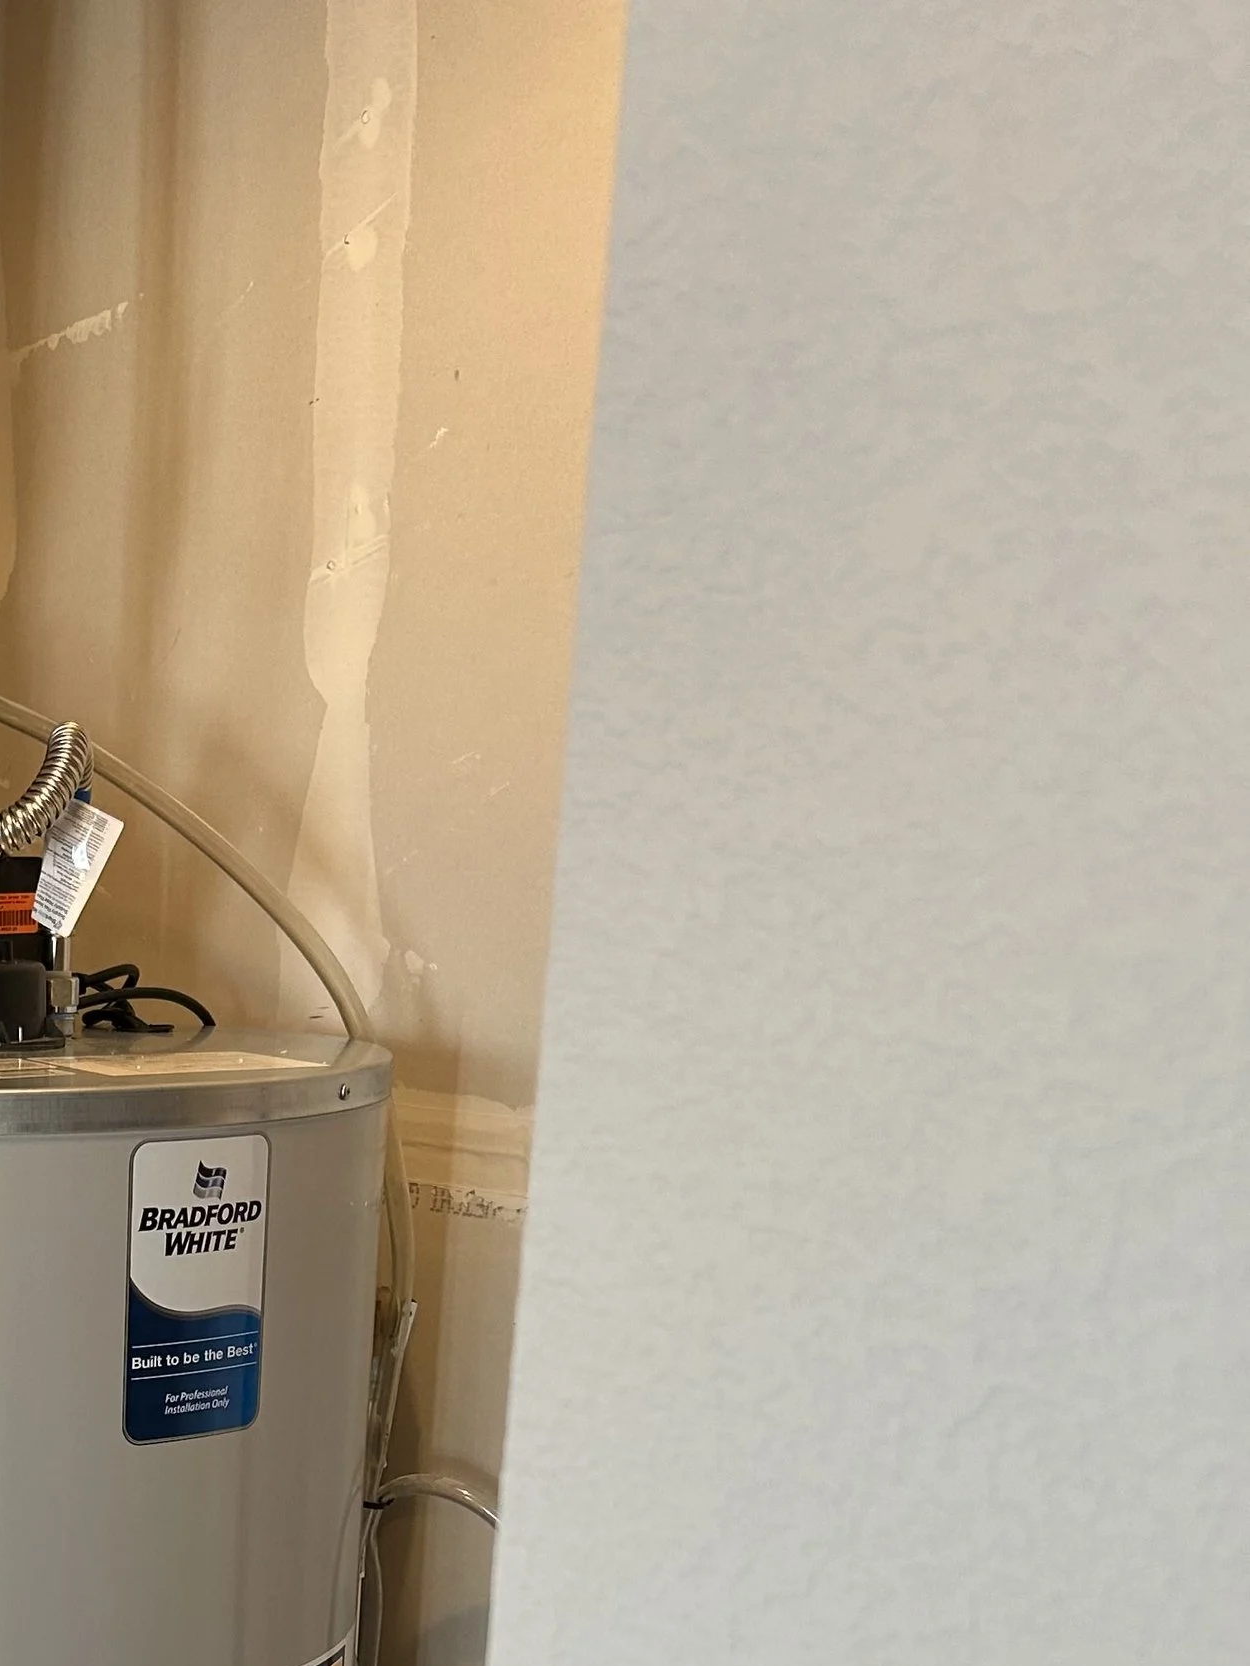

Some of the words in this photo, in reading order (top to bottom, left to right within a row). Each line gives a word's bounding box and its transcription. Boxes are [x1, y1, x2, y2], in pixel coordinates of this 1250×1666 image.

[138, 1200, 262, 1232] BRADFORD
[165, 1228, 238, 1257] WHITE
[131, 1353, 162, 1370] Built
[166, 1352, 180, 1366] to
[183, 1349, 199, 1364] be
[204, 1346, 223, 1362] the
[227, 1343, 253, 1359] Best
[164, 1400, 210, 1415] Installation
[212, 1397, 229, 1411] Only
[165, 1392, 179, 1403] For
[180, 1385, 229, 1401] Professional
